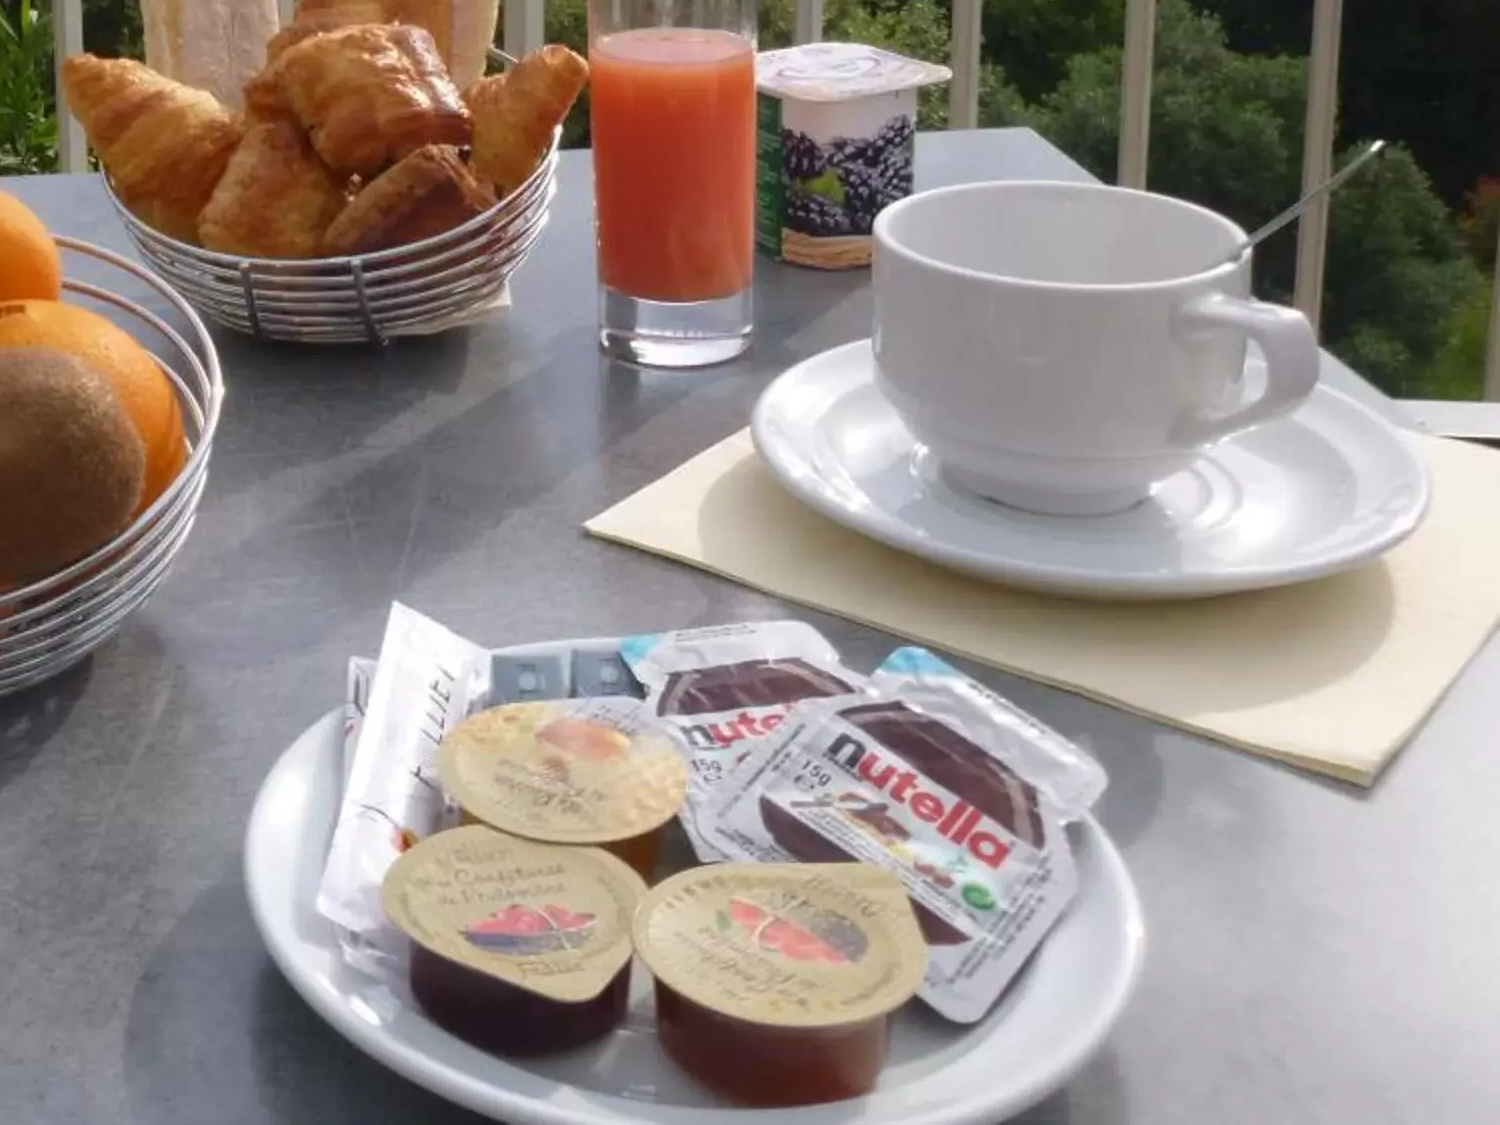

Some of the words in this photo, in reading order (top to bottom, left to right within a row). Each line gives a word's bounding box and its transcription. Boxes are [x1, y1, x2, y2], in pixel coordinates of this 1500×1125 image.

[679, 704, 790, 749] nute
[802, 760, 832, 787] 15g
[826, 732, 1012, 870] nutella
